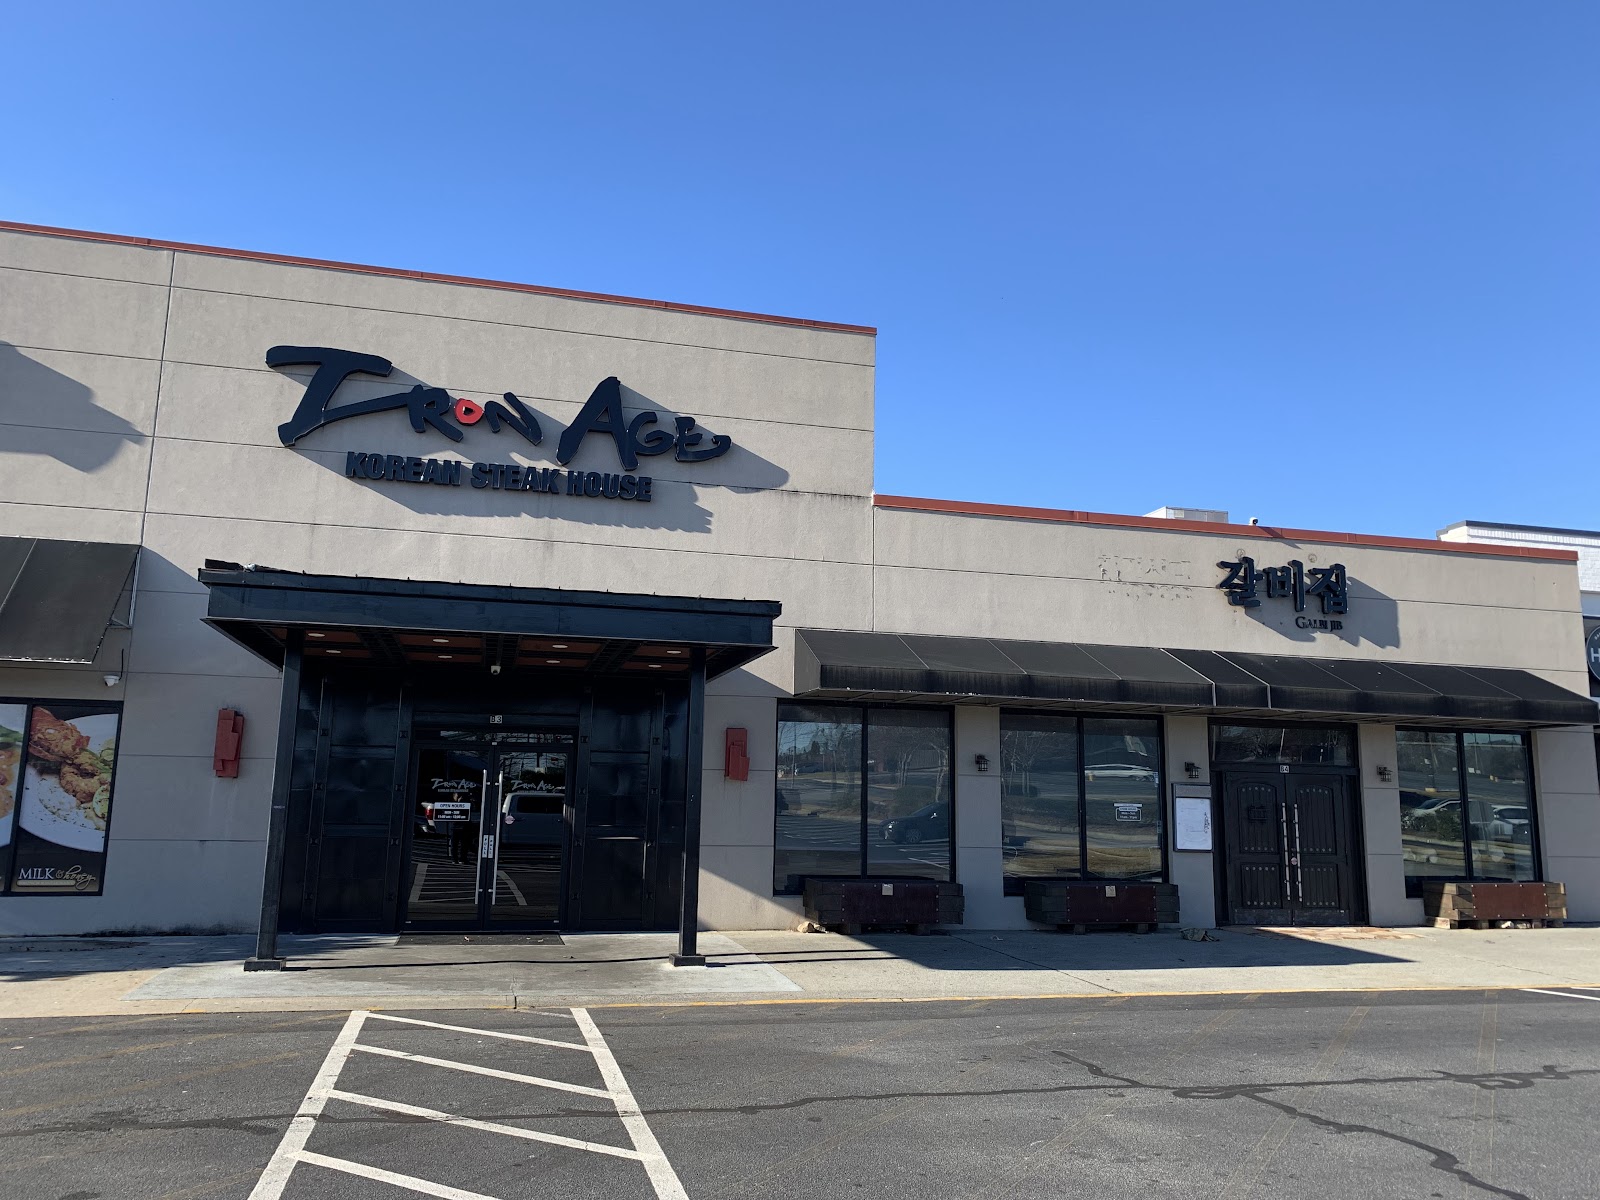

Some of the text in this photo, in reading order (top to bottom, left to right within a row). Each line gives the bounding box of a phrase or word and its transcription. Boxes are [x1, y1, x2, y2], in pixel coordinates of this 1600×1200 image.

[556, 376, 732, 471] AGE
[345, 451, 652, 503] KOREAN STEAK HOUSE
[1216, 556, 1347, 615] 갈비집
[18, 867, 55, 879] MILK
